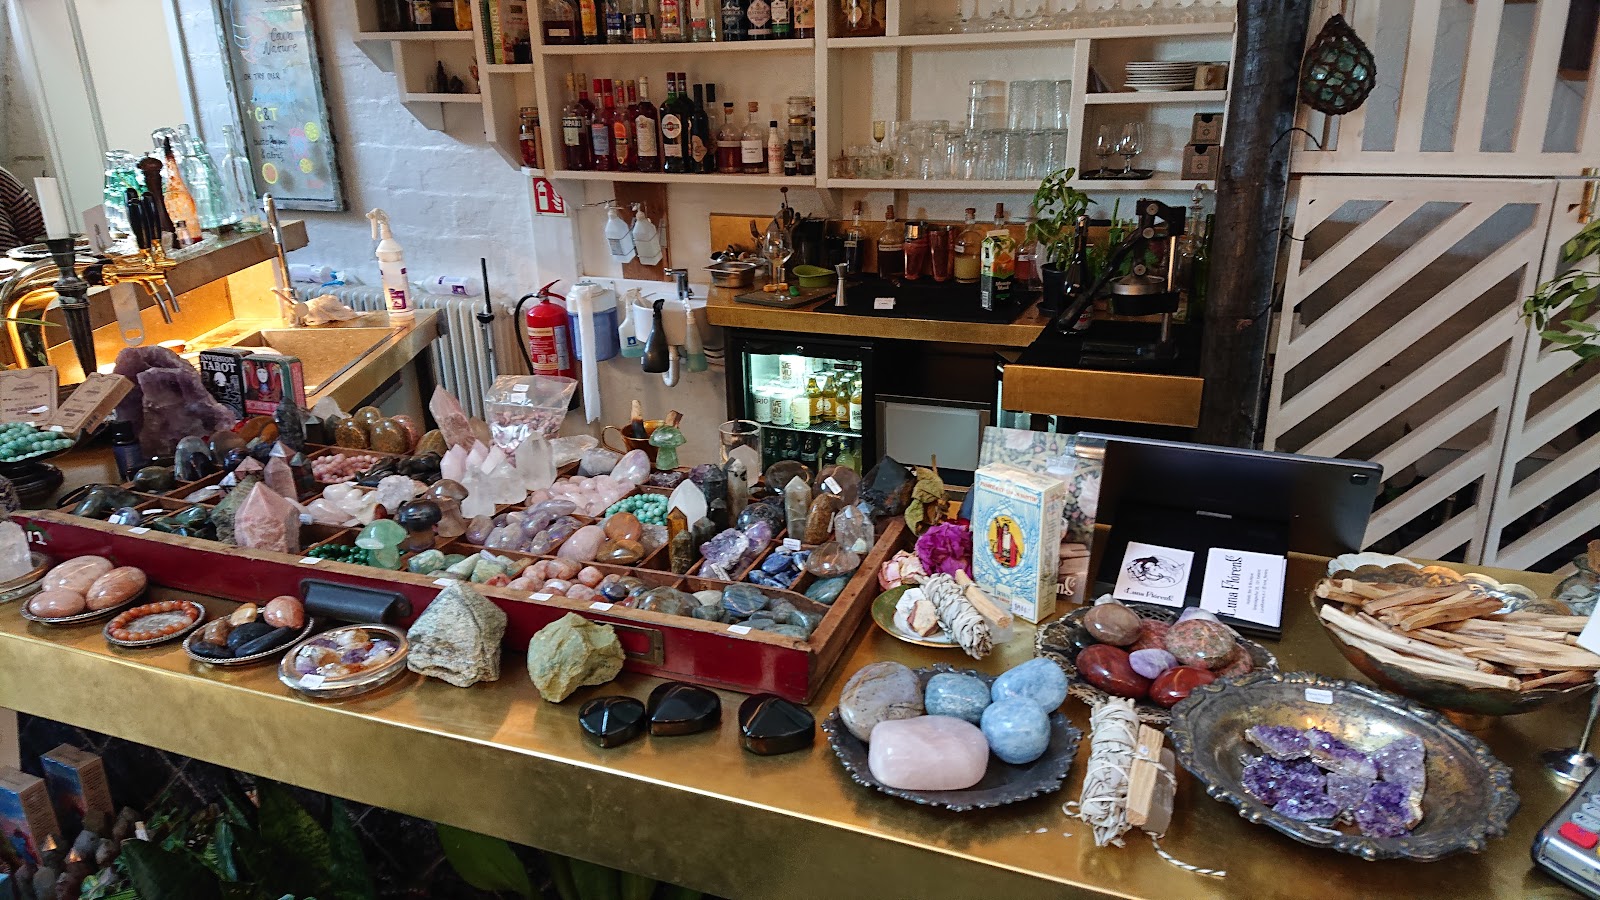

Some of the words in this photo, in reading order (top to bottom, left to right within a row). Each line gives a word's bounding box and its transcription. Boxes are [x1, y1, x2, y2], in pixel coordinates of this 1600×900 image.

[262, 42, 298, 56] Nature
[254, 107, 279, 123] G&T
[200, 354, 235, 363] INVERSION
[200, 361, 237, 373] TAROT
